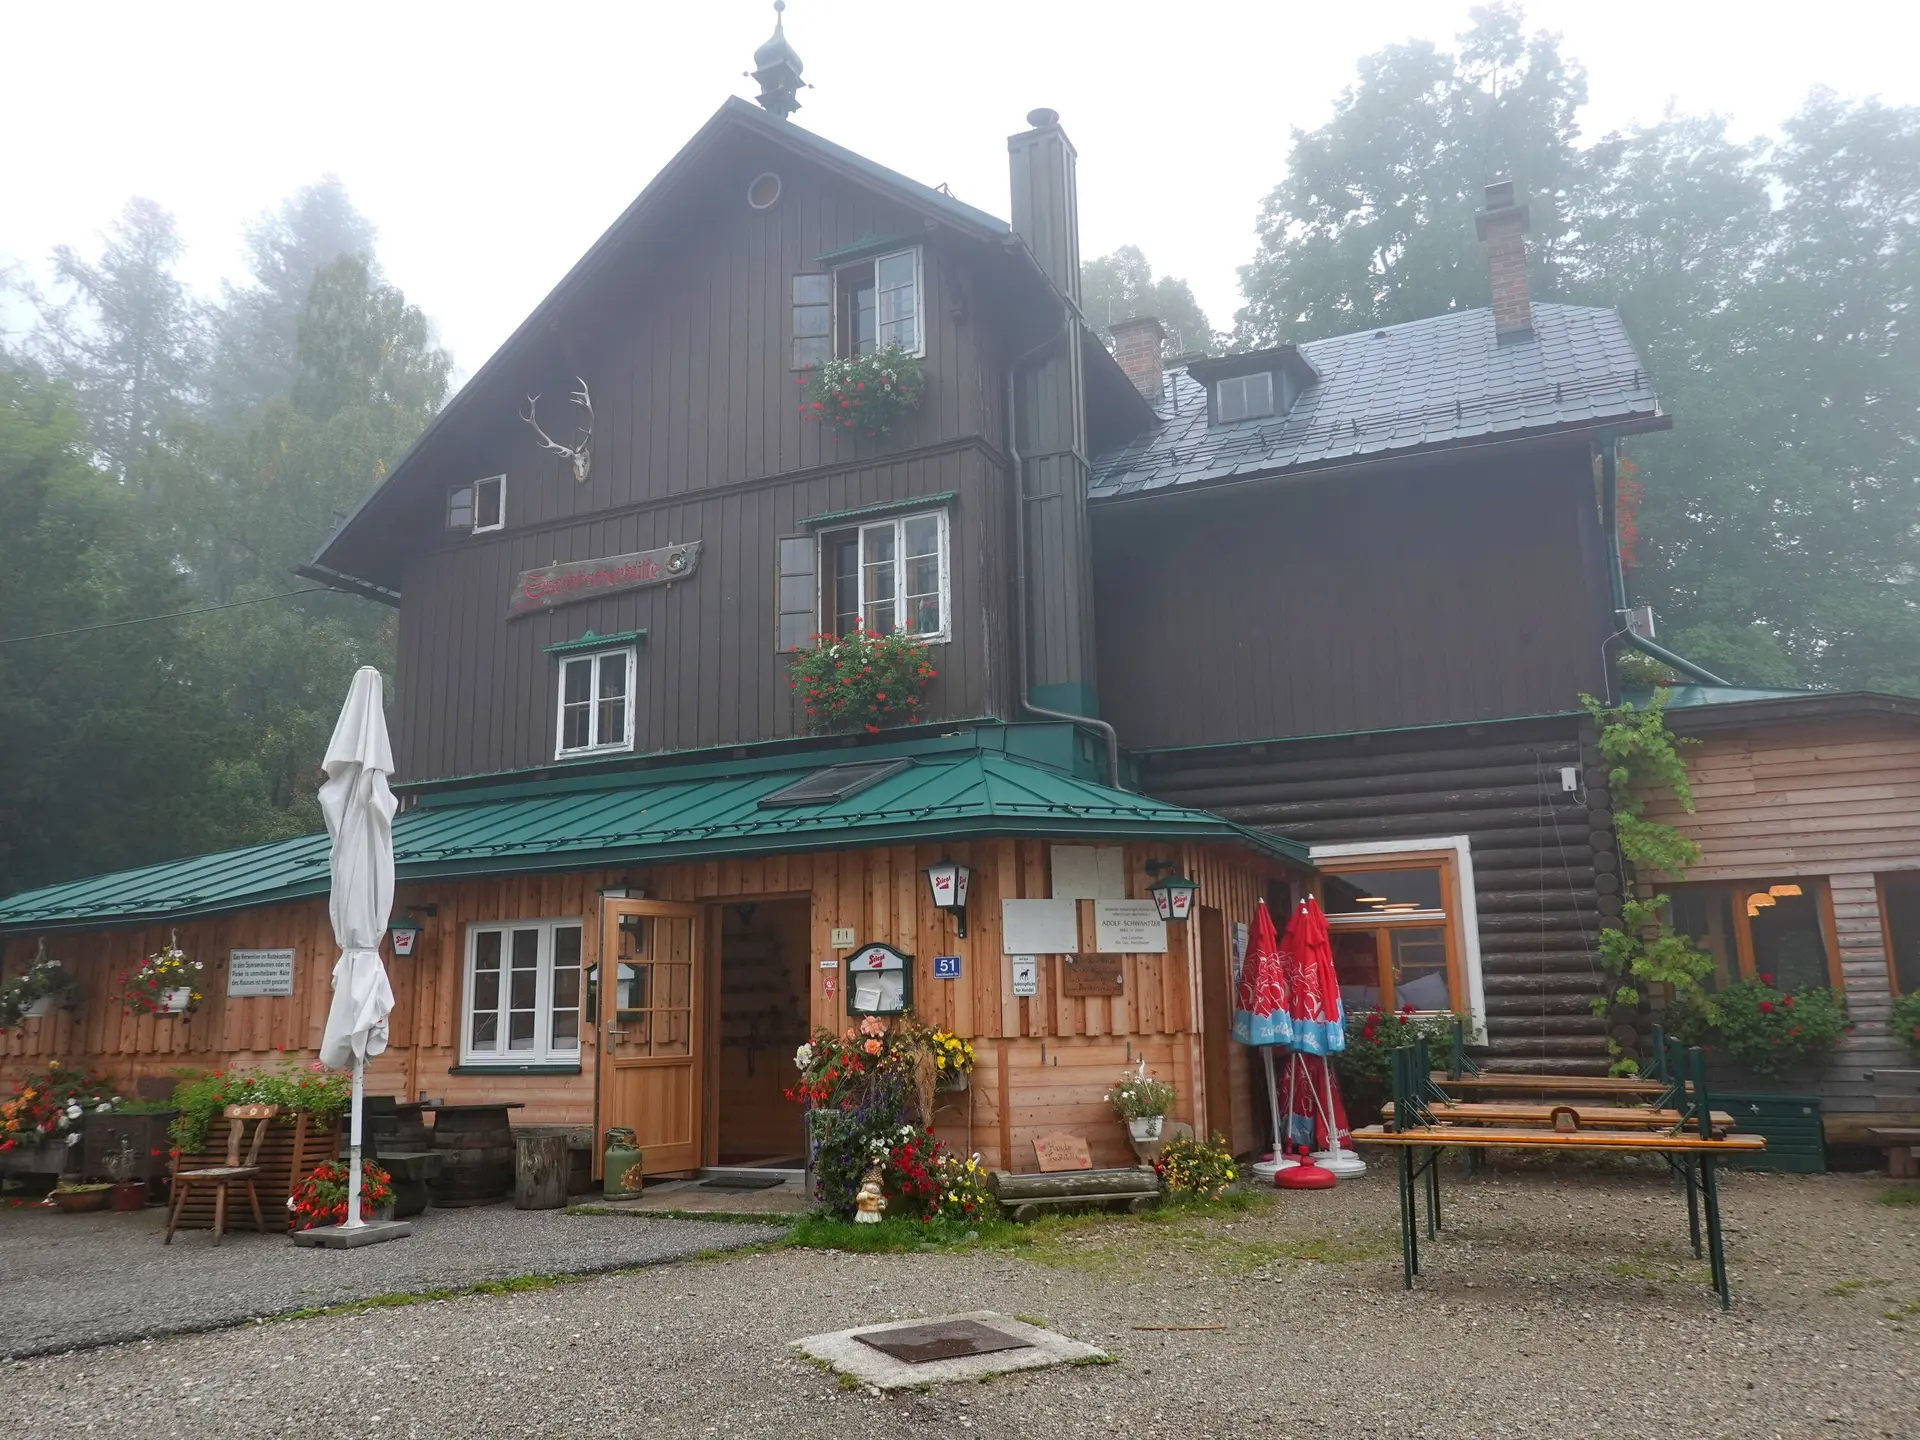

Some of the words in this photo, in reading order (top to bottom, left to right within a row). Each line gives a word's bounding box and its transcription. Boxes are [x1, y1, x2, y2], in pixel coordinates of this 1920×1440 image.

[935, 876, 951, 887] Stiegl
[869, 953, 885, 965] Stiegl
[940, 959, 955, 972] 51
